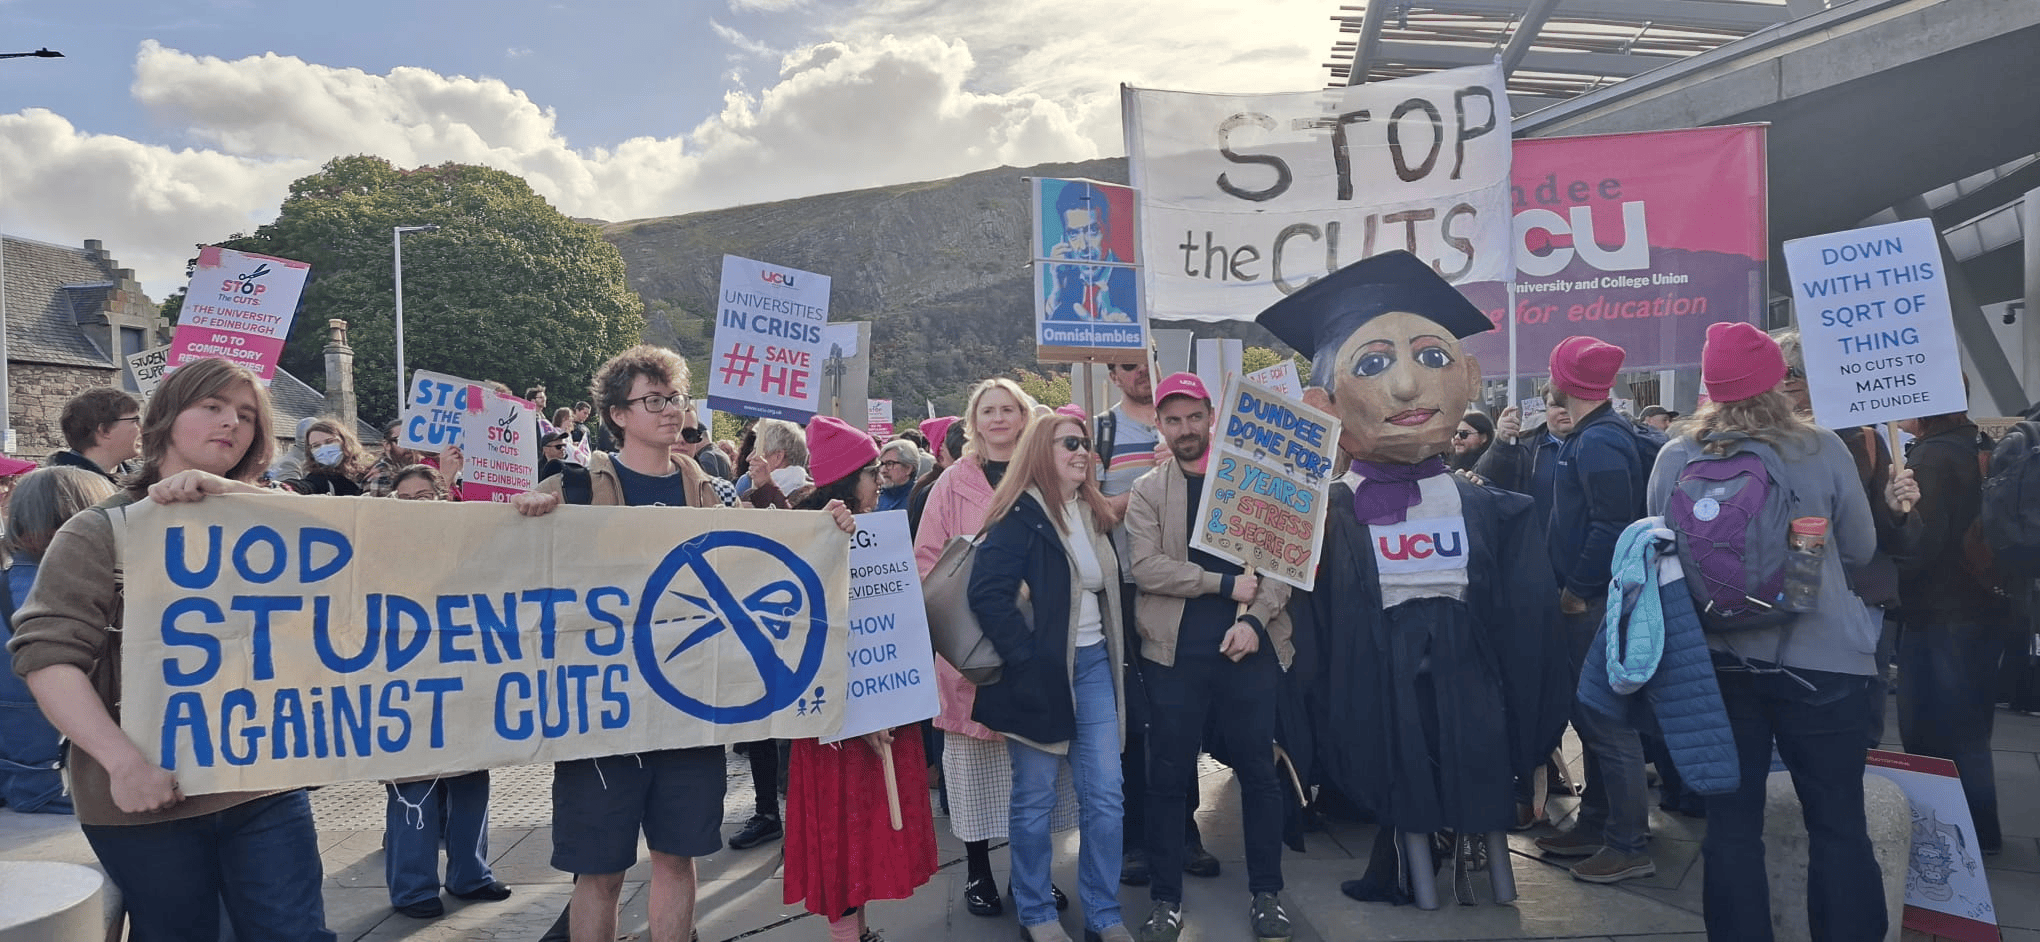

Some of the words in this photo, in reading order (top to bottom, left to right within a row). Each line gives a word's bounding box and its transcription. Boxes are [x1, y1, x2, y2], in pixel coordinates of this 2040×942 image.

[1216, 85, 1497, 202] STOP
[1511, 172, 1623, 207] ndee
[1179, 229, 1261, 281] the
[1821, 236, 1903, 266] DOWN
[221, 280, 267, 296] STOP
[1574, 277, 1599, 290] and
[1600, 275, 1650, 291] College
[1652, 272, 1689, 286] Union
[1803, 271, 1871, 299] WITH
[1876, 262, 1935, 287] THIS
[192, 304, 215, 315] THE
[217, 307, 282, 325] UNIVERSITY
[725, 289, 824, 321] UNIVERSITIES
[1515, 298, 1559, 325] for
[1567, 292, 1708, 323] education
[1821, 299, 1887, 328] SQRT
[1894, 294, 1926, 315] OF
[192, 315, 208, 325] OF
[209, 317, 275, 336] EDINBURGH
[211, 333, 229, 345] NO
[230, 336, 245, 346] TO
[723, 309, 748, 331] IN
[751, 314, 821, 345] CRISIS
[1043, 327, 1141, 343] Omnishambles
[187, 342, 263, 361] COMPULSORY
[1838, 327, 1920, 355] THING
[765, 345, 811, 369] SAVE
[1840, 363, 1862, 376] NO
[1865, 356, 1904, 372] CUTS
[1906, 352, 1926, 364] TO
[138, 364, 166, 381] SUPP
[760, 364, 809, 400] HE
[1856, 373, 1917, 394] MATHS
[415, 378, 468, 410] STO
[1849, 401, 1867, 413] AT
[1870, 391, 1931, 410] DUNDEE
[431, 408, 463, 425] THE
[1237, 392, 1327, 449] DUNDEE
[408, 414, 466, 451] CUT
[487, 425, 520, 443] STOP
[1226, 415, 1286, 457] DONE
[1283, 440, 1333, 479] FOR?
[471, 456, 488, 467] THE
[489, 457, 533, 476] UNIVERSITY
[473, 470, 486, 481] OF
[487, 472, 531, 489] EDINBURGH
[1217, 457, 1237, 482] 2
[1238, 463, 1314, 514] YEARS
[1237, 494, 1314, 541] STRESS
[1207, 508, 1228, 536] &
[1229, 514, 1313, 568] SECRECY
[163, 524, 354, 591] UOD
[850, 560, 909, 579] ROPOSALS
[160, 585, 631, 689] STUDENTS
[847, 612, 895, 638] HOW
[847, 643, 898, 668] YOUR
[493, 662, 631, 742] CUTS
